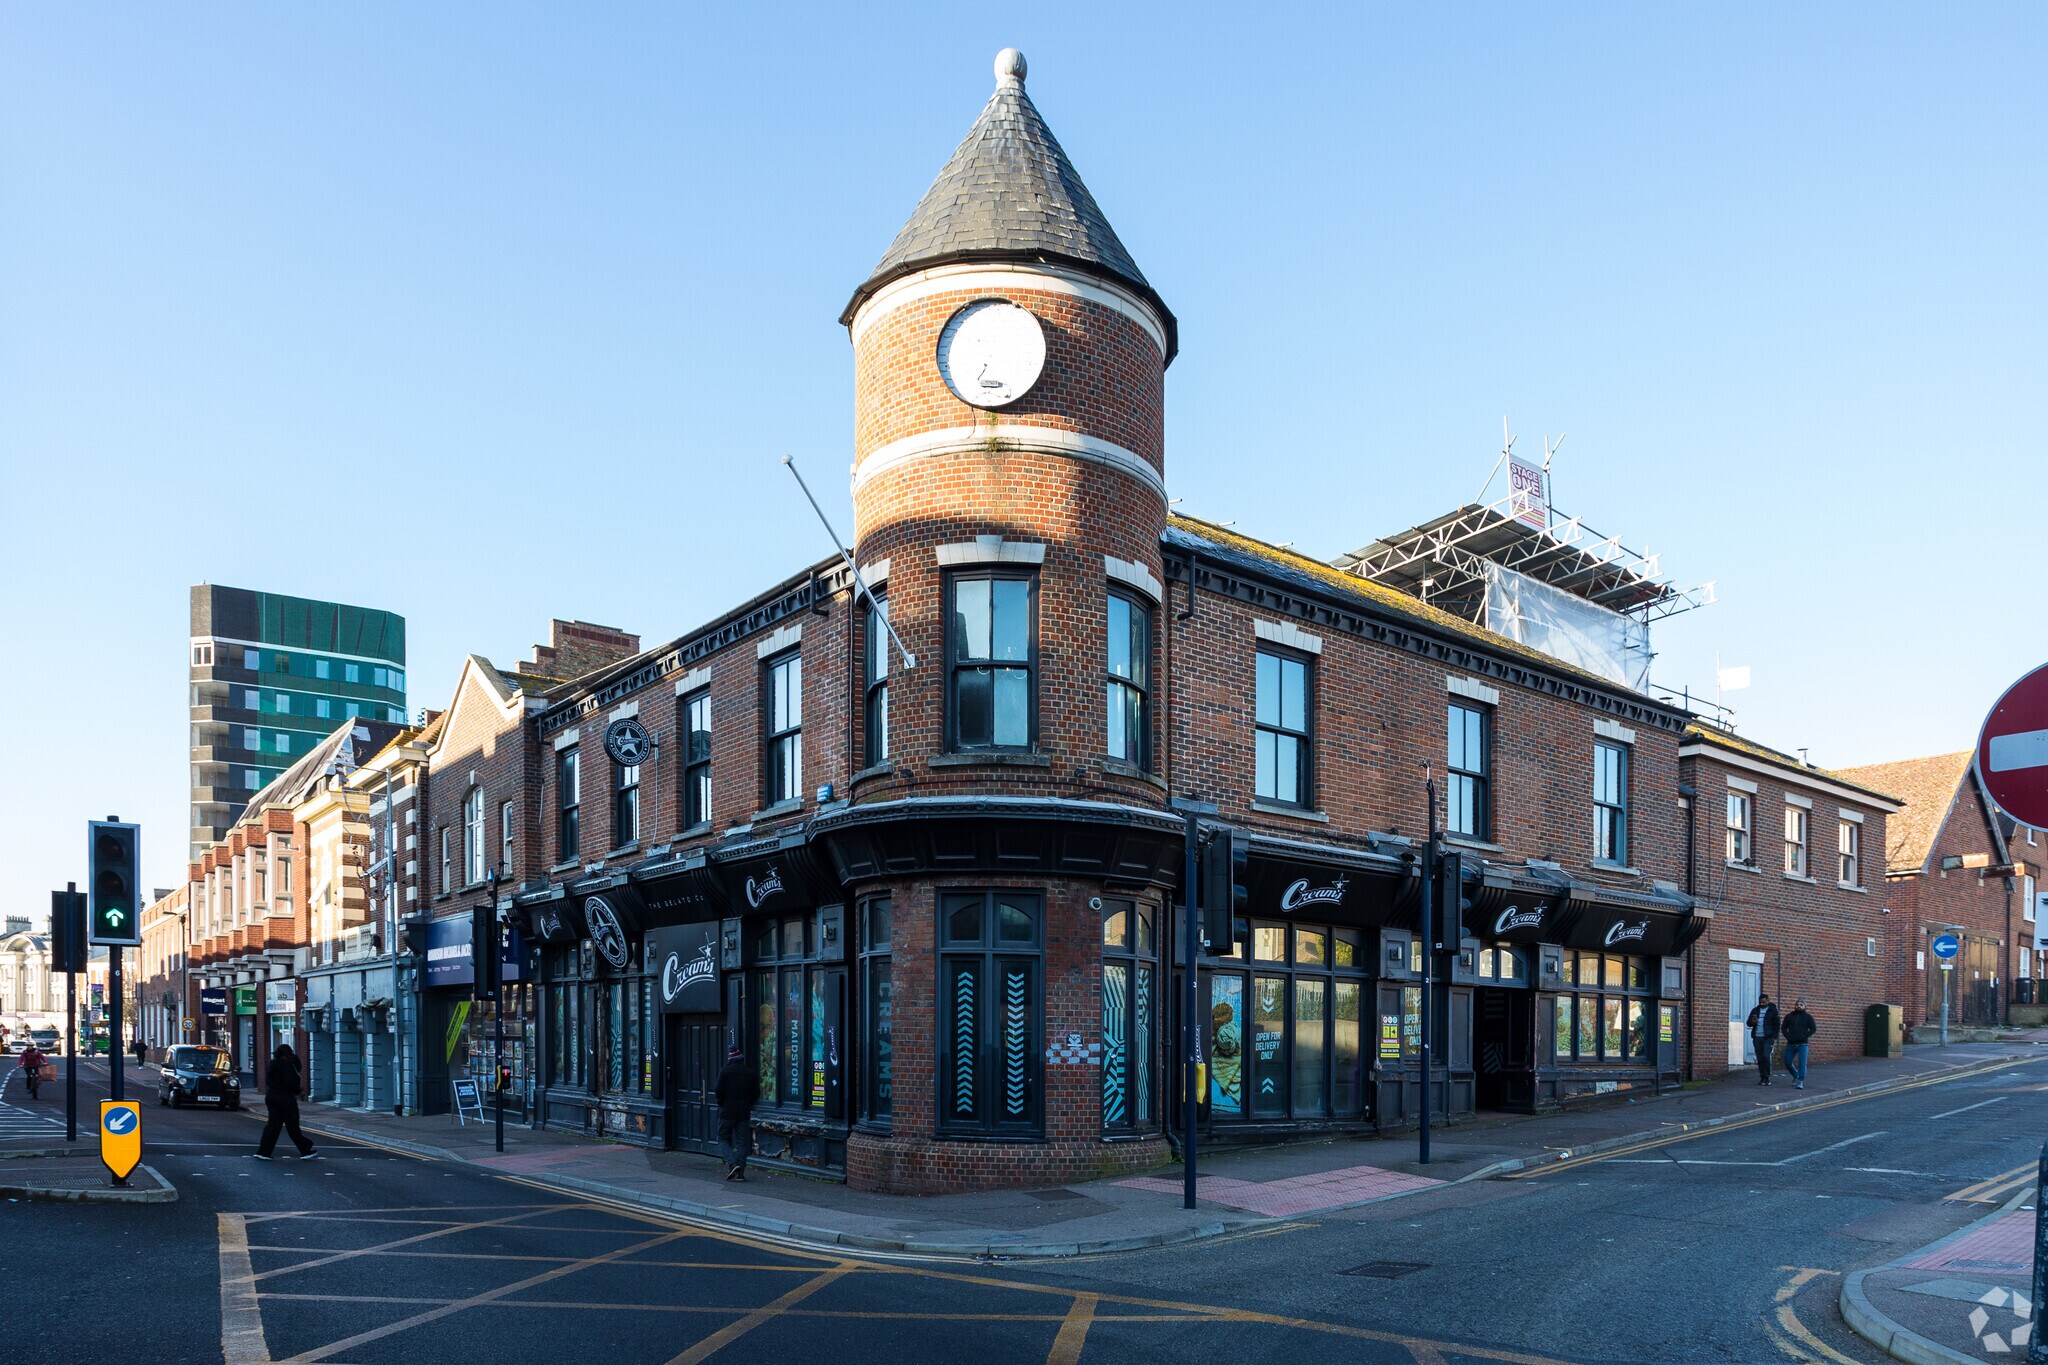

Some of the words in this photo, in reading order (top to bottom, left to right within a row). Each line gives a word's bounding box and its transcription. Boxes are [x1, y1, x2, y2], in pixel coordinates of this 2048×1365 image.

[1511, 462, 1539, 482] STAGE
[648, 902, 662, 910] THE
[664, 896, 692, 908] GELATO
[662, 951, 715, 1005] Cream's
[202, 996, 225, 1004] Magnet
[1404, 1013, 1419, 1025] OPEN
[879, 982, 892, 1099] CREAMS
[1255, 1032, 1270, 1042] OPEN
[1270, 1031, 1281, 1041] FOR
[1409, 1035, 1421, 1046] ONL
[1255, 1041, 1281, 1052] DELIVERY
[790, 1019, 799, 1096] MAIDSTONE
[1260, 1050, 1274, 1060] ONLY
